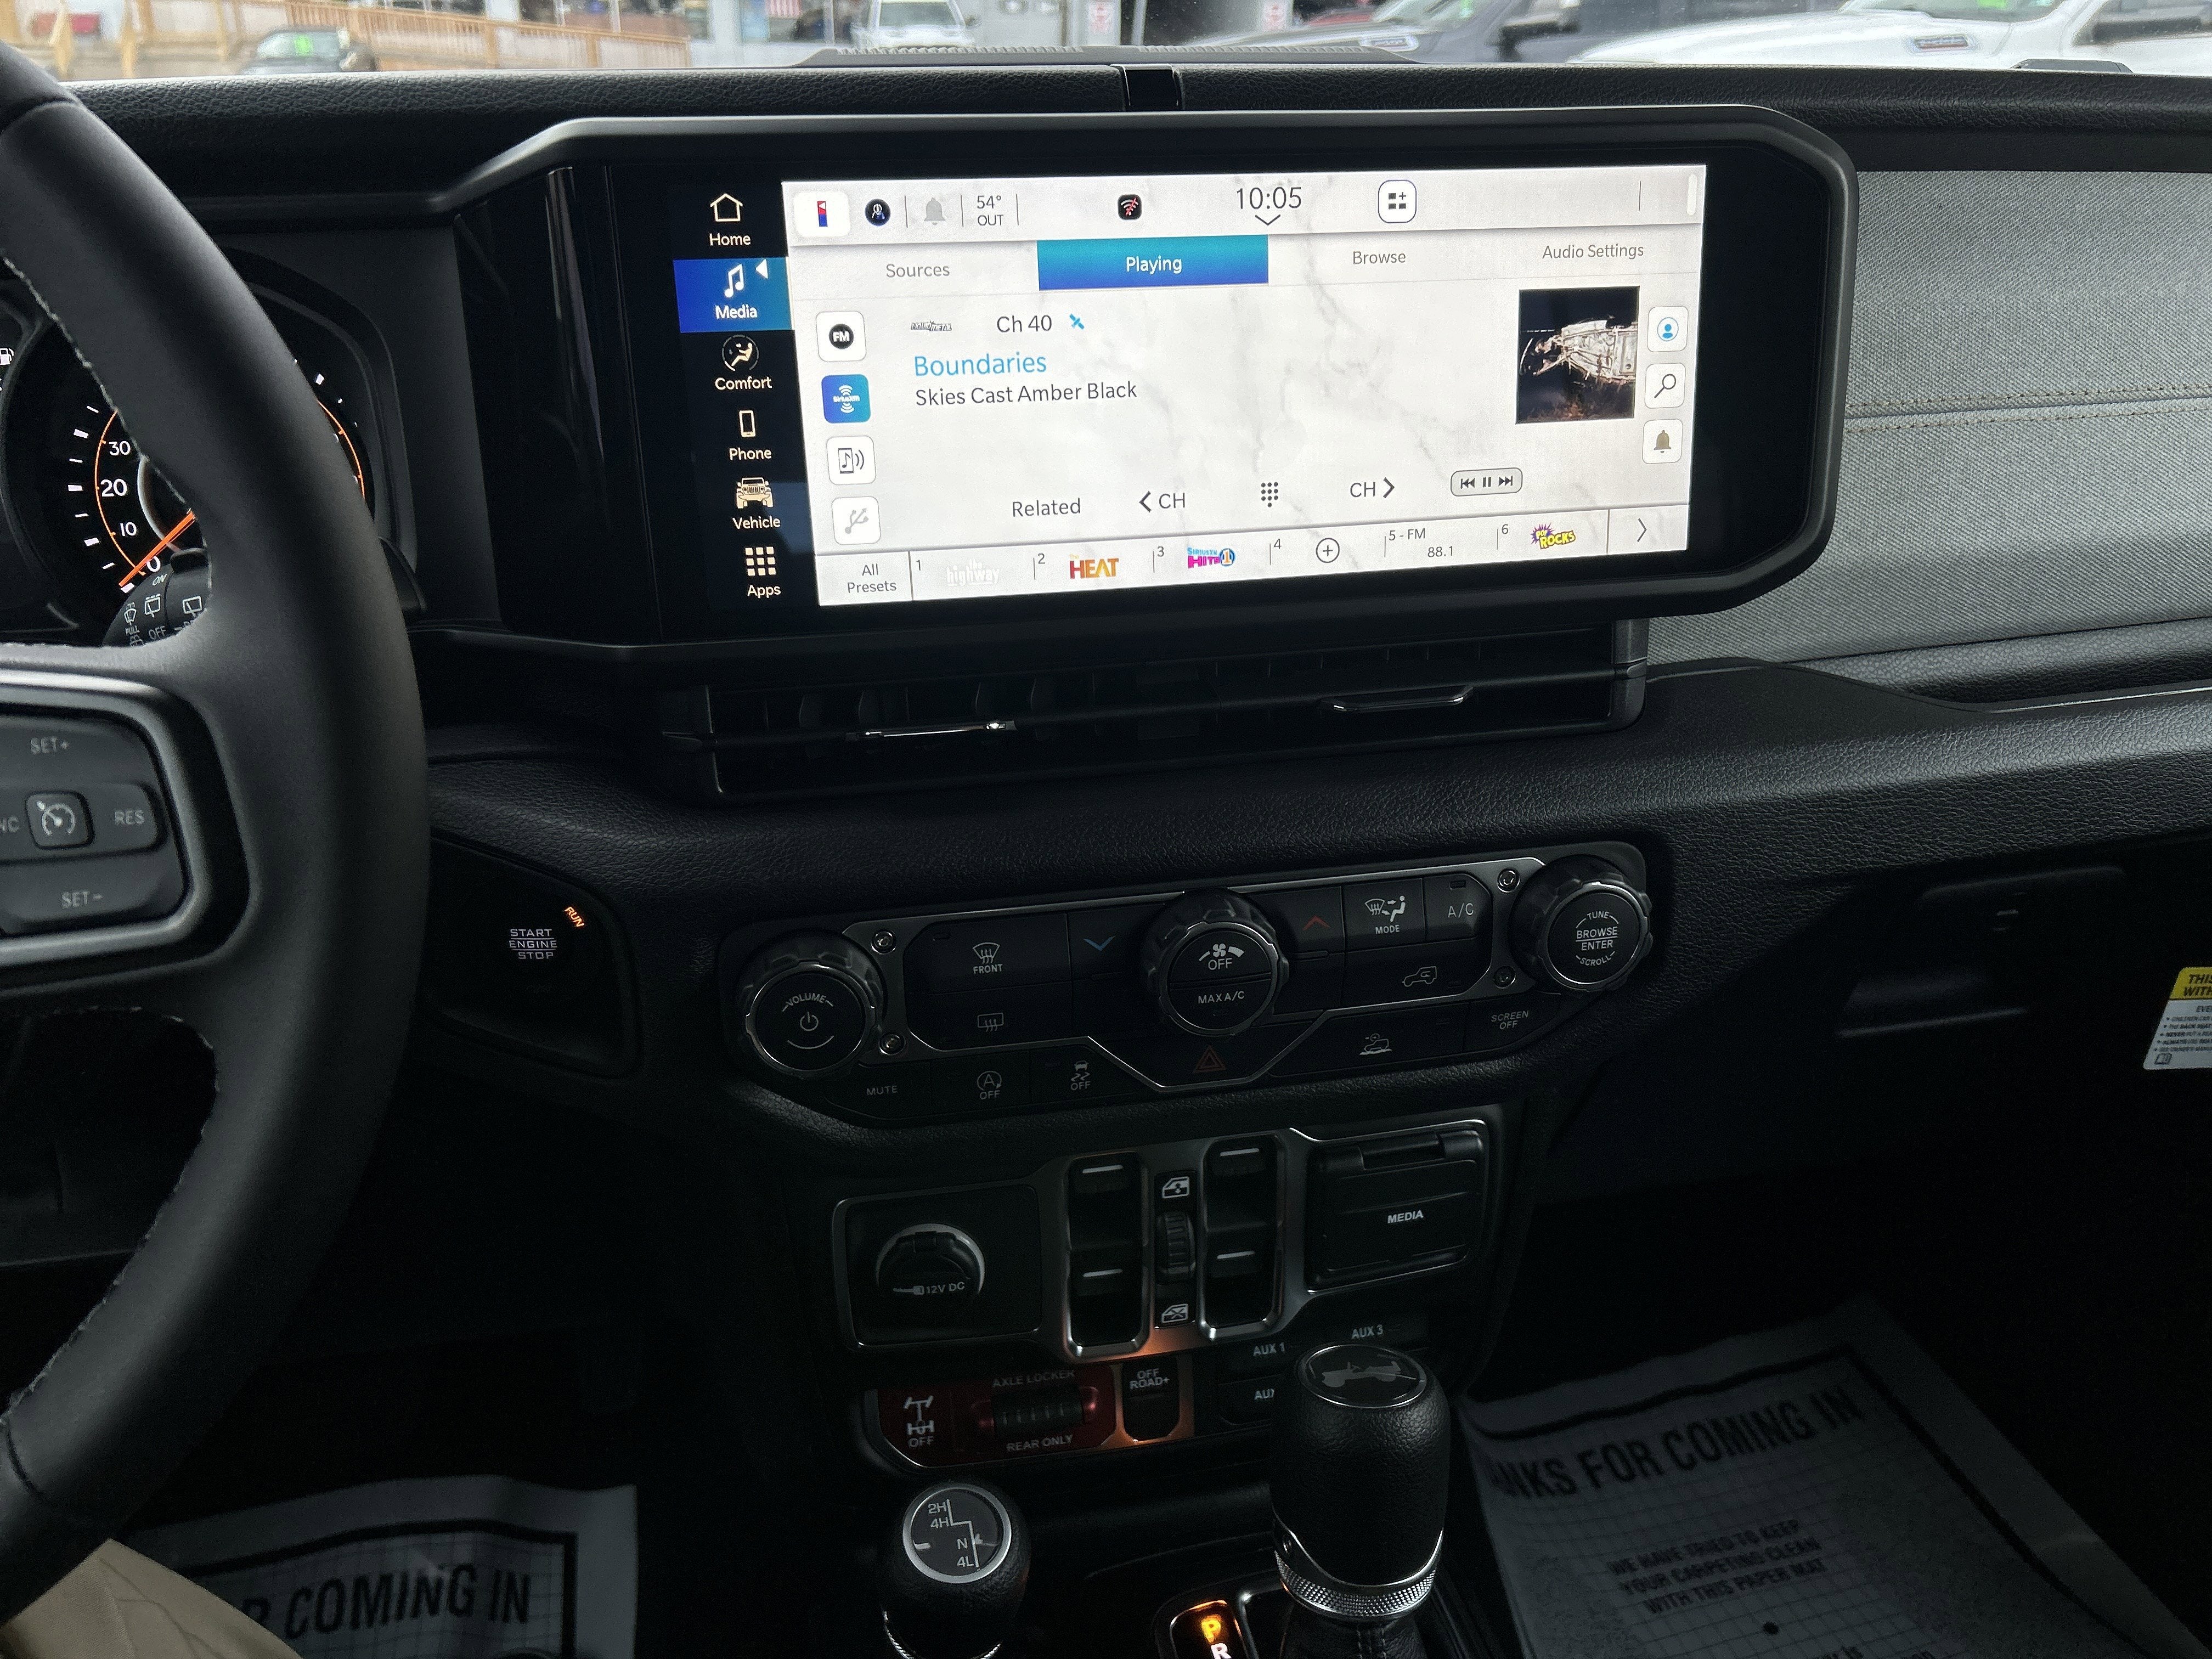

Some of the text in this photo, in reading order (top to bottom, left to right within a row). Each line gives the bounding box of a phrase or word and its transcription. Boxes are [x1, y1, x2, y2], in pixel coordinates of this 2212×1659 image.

[977, 195, 1002, 210] 54°
[1236, 187, 1303, 211] 10:05
[977, 214, 1005, 227] OUT
[709, 233, 752, 246] Home
[1352, 250, 1407, 266] Browse
[1542, 243, 1645, 260] Audio Settings
[885, 263, 951, 278] Sources
[1126, 255, 1183, 275] Playing
[715, 305, 758, 319] Media
[996, 314, 1053, 333] Ch 40
[832, 331, 850, 342] FM
[915, 352, 1047, 377] Boundaries
[715, 376, 772, 391] Comfort
[916, 381, 1138, 407] Skies Cast Amber Black
[109, 441, 131, 456] 30
[729, 447, 772, 461] Phone
[100, 479, 127, 497] 20
[1350, 482, 1376, 498] CH
[1012, 498, 1082, 517] Related
[1159, 492, 1187, 509] CH
[120, 522, 137, 537] 10
[732, 516, 781, 529] Vehicle
[1501, 524, 1509, 535] 6
[1389, 531, 1396, 541] 5
[1407, 528, 1426, 540] FM
[1539, 530, 1576, 549] ROCKS
[1156, 546, 1165, 557] 3
[1273, 539, 1282, 550] 4
[1037, 552, 1046, 564] 2
[1427, 546, 1454, 558] 88.1
[862, 563, 879, 577] All
[916, 560, 922, 571] 1
[1070, 557, 1119, 579] HEAT
[152, 573, 167, 586] ON
[847, 579, 897, 594] Presets
[747, 584, 781, 599] Apps
[125, 625, 140, 636] PULL
[149, 625, 166, 640] OFF
[114, 809, 145, 826] RES
[563, 906, 585, 928] RUN
[1448, 902, 1475, 918] A/C
[1586, 910, 1611, 922] TUNE
[510, 928, 552, 937] START
[1375, 924, 1401, 935] MODE
[1576, 926, 1618, 939] BROWSE
[509, 940, 558, 949] ENGINE
[1581, 939, 1614, 951] ENTER
[518, 951, 554, 960] STOP
[1579, 955, 1612, 967] SCROLL
[973, 963, 1003, 974] FRONT
[1207, 957, 1233, 970] OFF
[785, 992, 827, 1007] VOLUME
[1198, 989, 1245, 1004] MAX A/C
[1491, 1010, 1530, 1024] SCREEN
[1499, 1019, 1519, 1030] OFF
[866, 1085, 899, 1097] MUTE
[1070, 1080, 1092, 1091] OFF
[979, 1090, 1001, 1101] OFF
[1387, 1210, 1424, 1224] MEDIA
[926, 1282, 965, 1294] 12V DC
[1351, 1325, 1384, 1339] AUX 3
[1253, 1342, 1285, 1356] AUX 1
[992, 1370, 1075, 1389] AXLE LOCKER
[1137, 1369, 1160, 1380] OFF
[908, 1435, 935, 1448] OFF
[1007, 1434, 1074, 1452] REAR ONLY
[1577, 1438, 1665, 1489] FOR
[1661, 1400, 1817, 1471] COMING
[1810, 1385, 1864, 1429] IN
[928, 1502, 947, 1514] 2H
[930, 1517, 949, 1529] 4H
[957, 1538, 968, 1550] N
[957, 1556, 974, 1568] 4L
[1618, 1572, 1672, 1595] YOUR
[1764, 1536, 1822, 1561] CLEAN
[285, 1563, 478, 1640] COMING
[489, 1570, 532, 1624] IN
[1643, 1590, 1694, 1615] WITH
[1202, 1618, 1222, 1641] P
[1210, 1643, 1231, 1659] R
